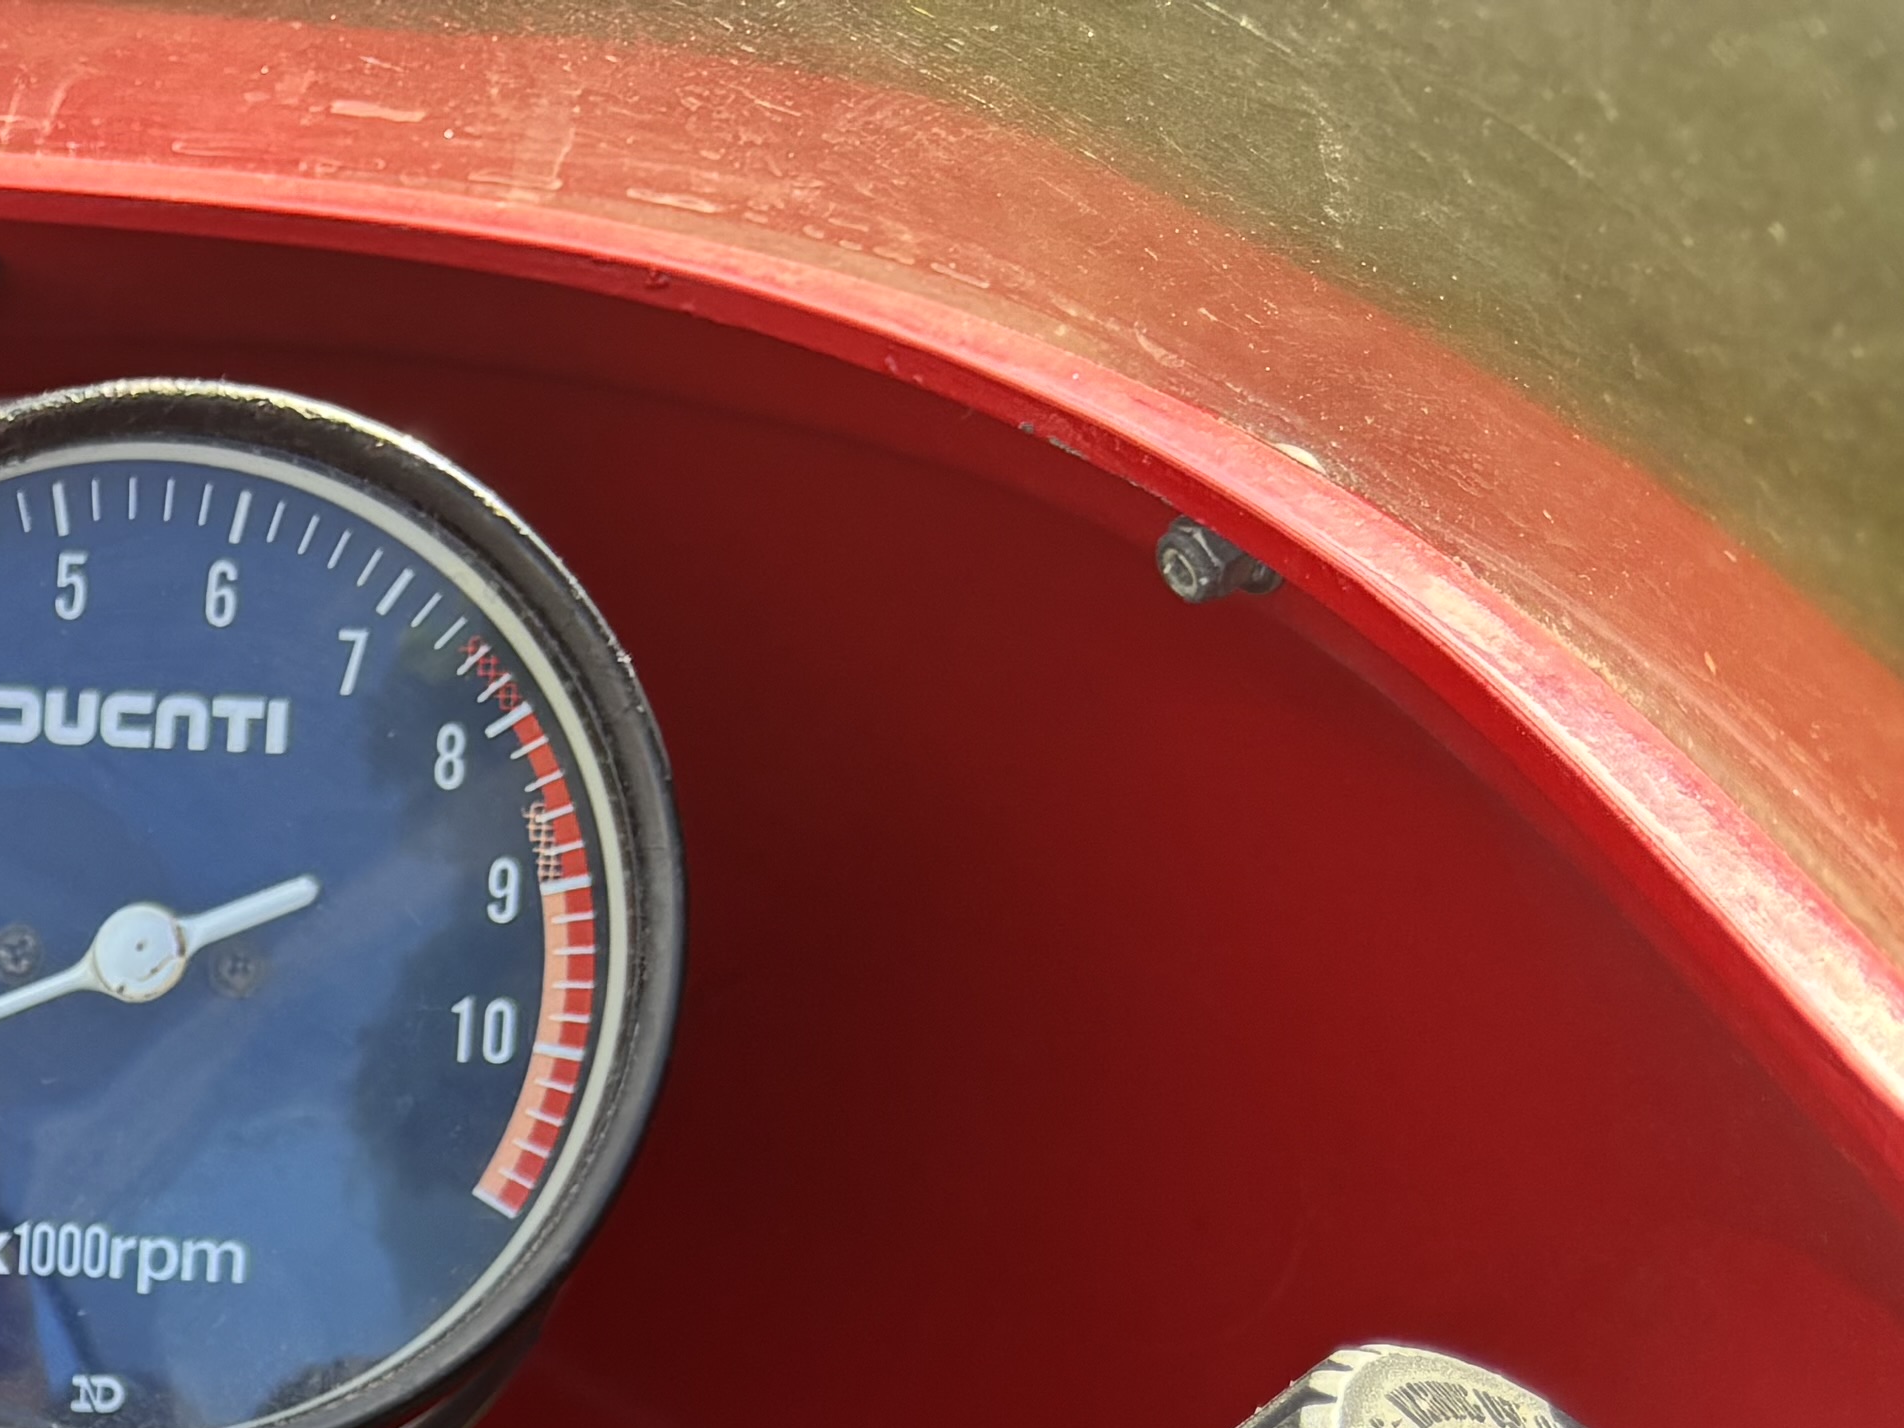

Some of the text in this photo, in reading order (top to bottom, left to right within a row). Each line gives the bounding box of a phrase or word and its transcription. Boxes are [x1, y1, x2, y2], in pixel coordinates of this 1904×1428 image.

[54, 552, 87, 621] 5
[205, 559, 238, 628] 6
[338, 628, 369, 696] 7
[434, 723, 466, 791] 8
[487, 857, 520, 924] 9
[451, 996, 516, 1064] 10
